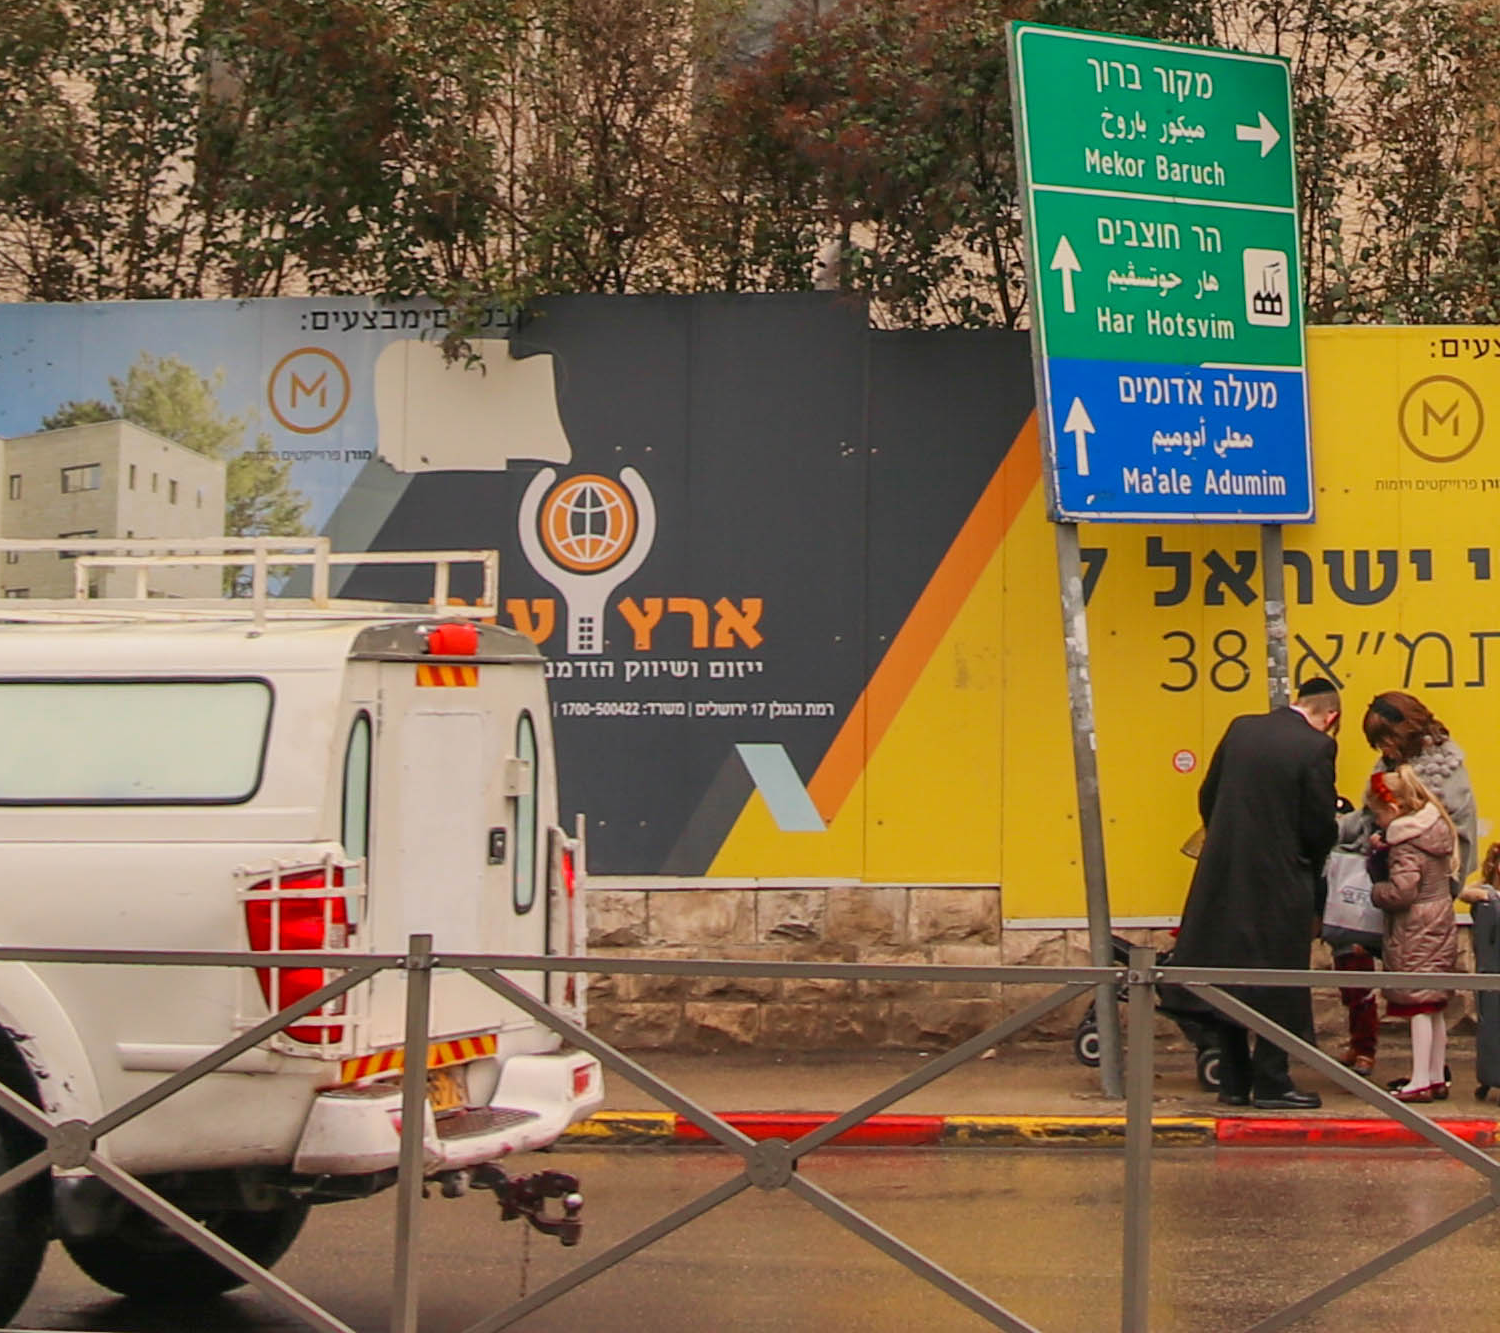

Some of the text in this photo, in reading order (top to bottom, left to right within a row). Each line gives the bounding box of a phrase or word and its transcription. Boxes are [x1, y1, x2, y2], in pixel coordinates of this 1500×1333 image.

[1087, 57, 1213, 103] מקור ברוך
[1101, 106, 1206, 145] ميكور باروخ
[1084, 147, 1226, 187] Mekor Baruch
[1097, 217, 1222, 254] הר חוצבים
[1195, 269, 1219, 300] هار
[301, 309, 419, 332] מבצעים:
[1097, 306, 1235, 340] Har Hotsvim
[290, 370, 327, 409] M
[1118, 373, 1278, 412] מעלה אדומים
[1422, 399, 1460, 436] M
[1122, 465, 1287, 496] Ma'ale Adumim
[1146, 536, 1432, 608] ישראל
[617, 596, 764, 651] ארץ
[623, 661, 699, 682] ושיווק
[709, 661, 764, 679] ייזום
[1160, 629, 1251, 693] 38
[560, 700, 835, 720] רמת הגולן 17 ירושלים משרד: 1700-500422
